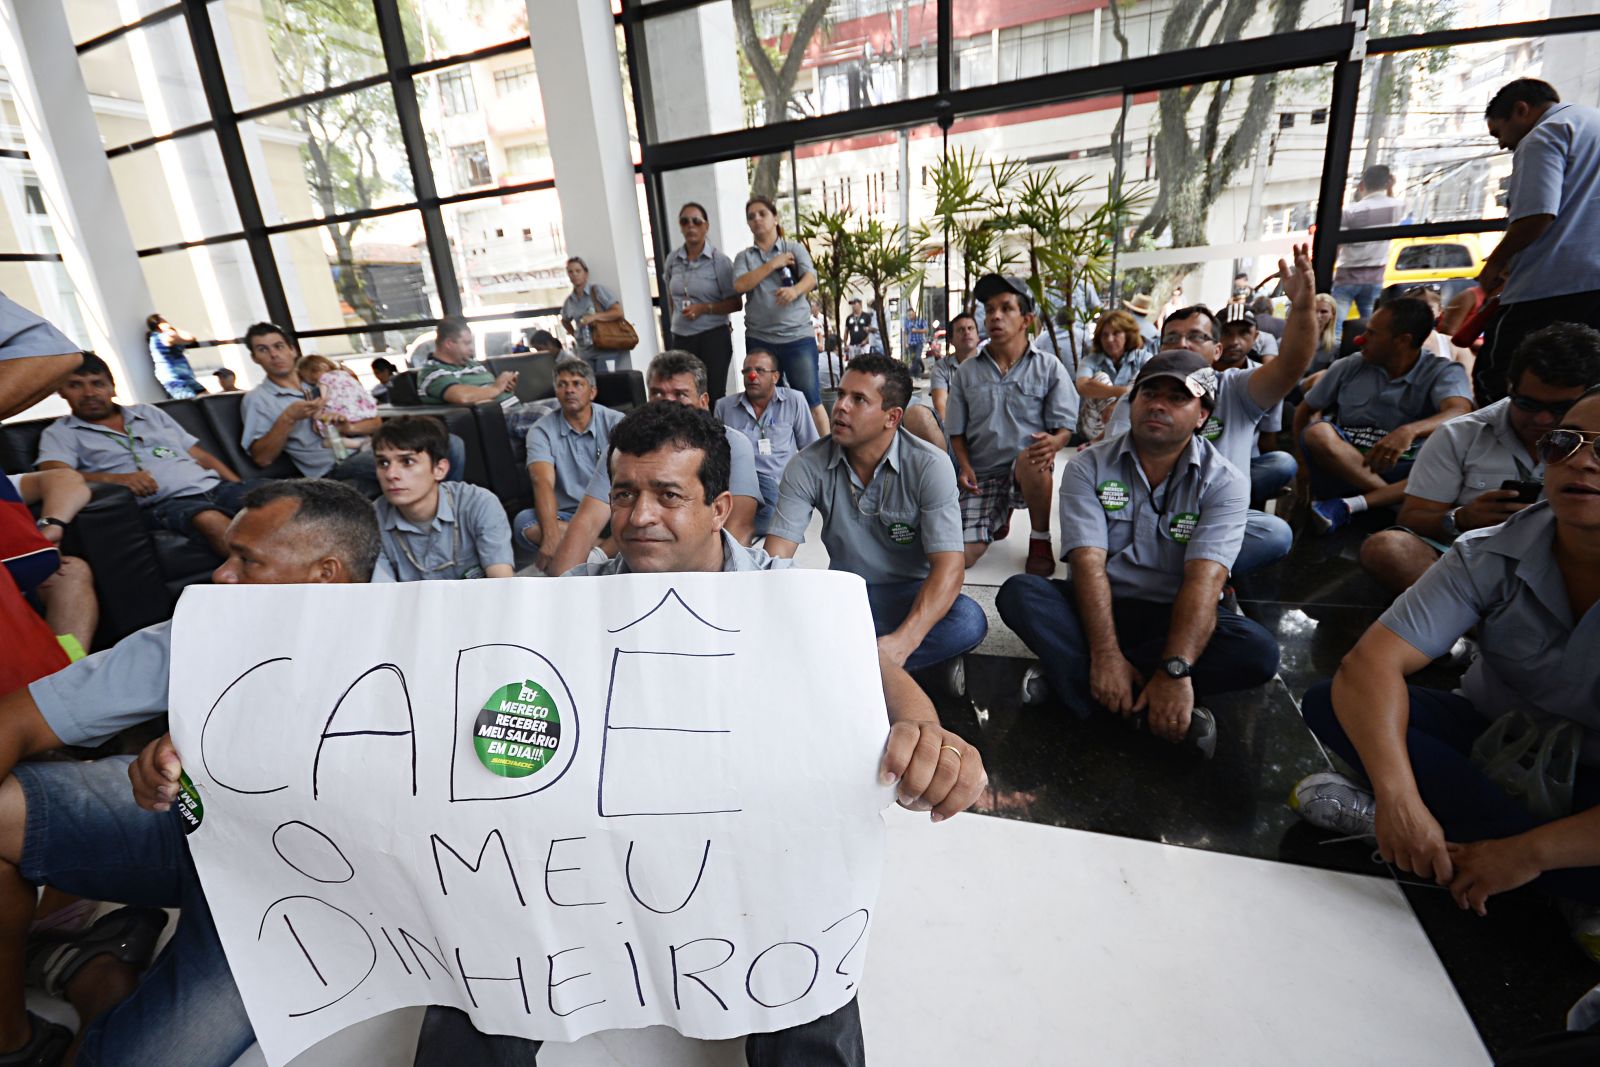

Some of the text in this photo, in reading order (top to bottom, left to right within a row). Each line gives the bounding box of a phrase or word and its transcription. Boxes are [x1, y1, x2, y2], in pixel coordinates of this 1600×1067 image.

[201, 588, 742, 818] CADÊ
[518, 686, 538, 702] EU
[499, 700, 549, 719] MEREÇO
[496, 713, 548, 733] RECEBER
[478, 725, 558, 749] MEU SALÁRIO
[487, 741, 542, 761] EM DIA!!!
[490, 758, 535, 769] SINDIMOC
[178, 803, 199, 825] MEU
[272, 820, 711, 915] O MEU
